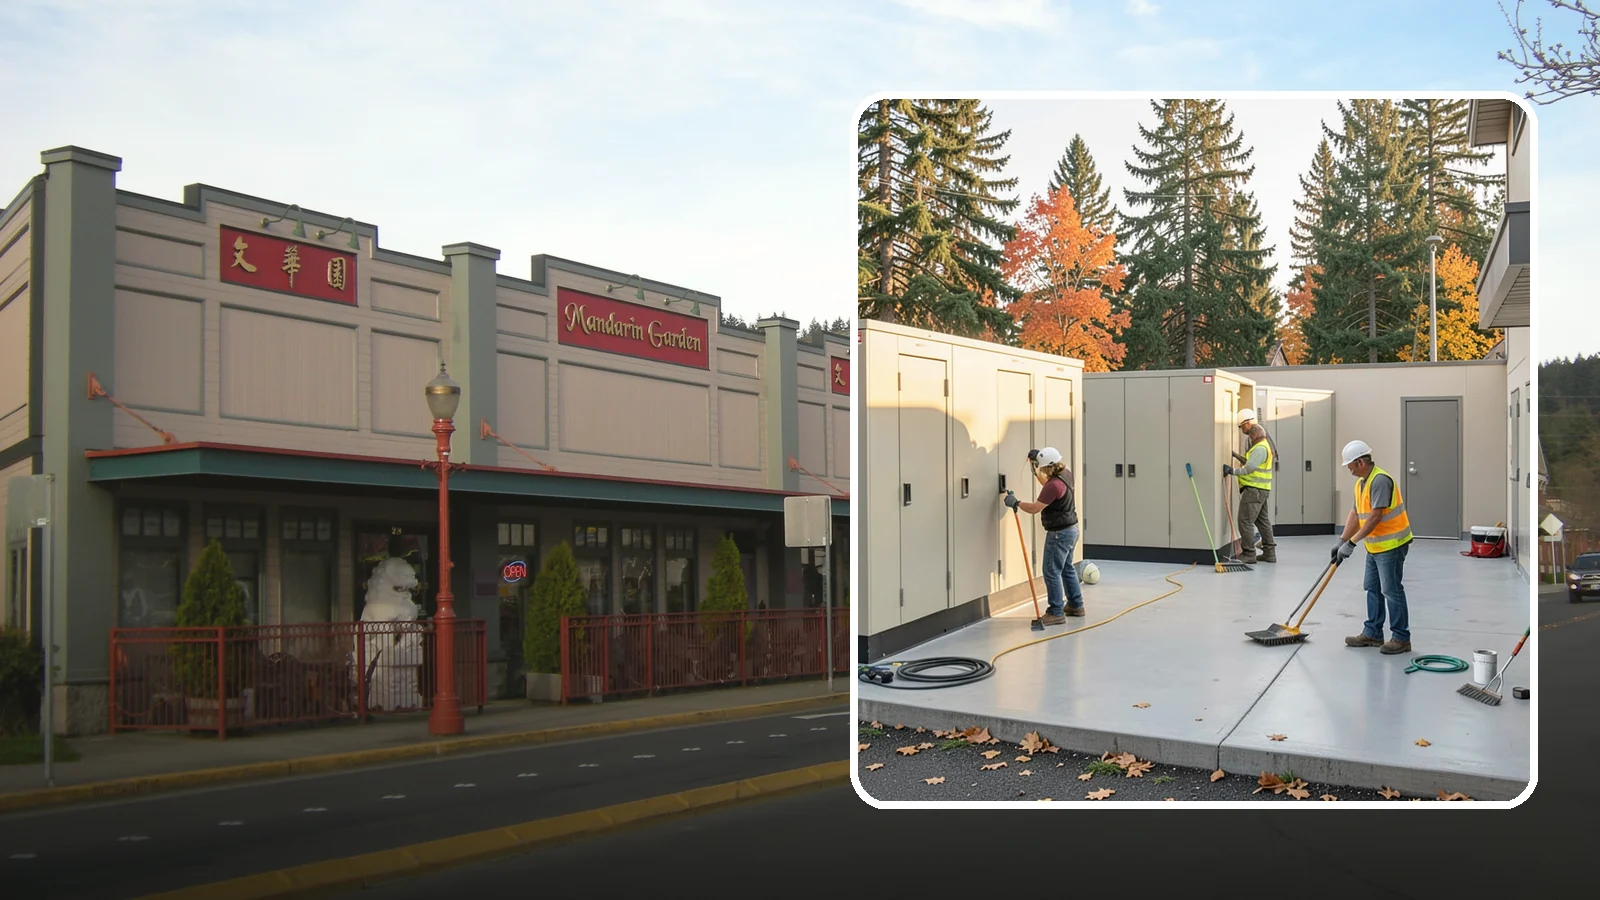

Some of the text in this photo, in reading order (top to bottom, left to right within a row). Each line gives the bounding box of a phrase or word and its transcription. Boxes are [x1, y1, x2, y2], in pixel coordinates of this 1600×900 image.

[231, 235, 346, 291] 文華園
[564, 302, 701, 352] Mandarin Garden
[503, 565, 527, 578] OPEN
